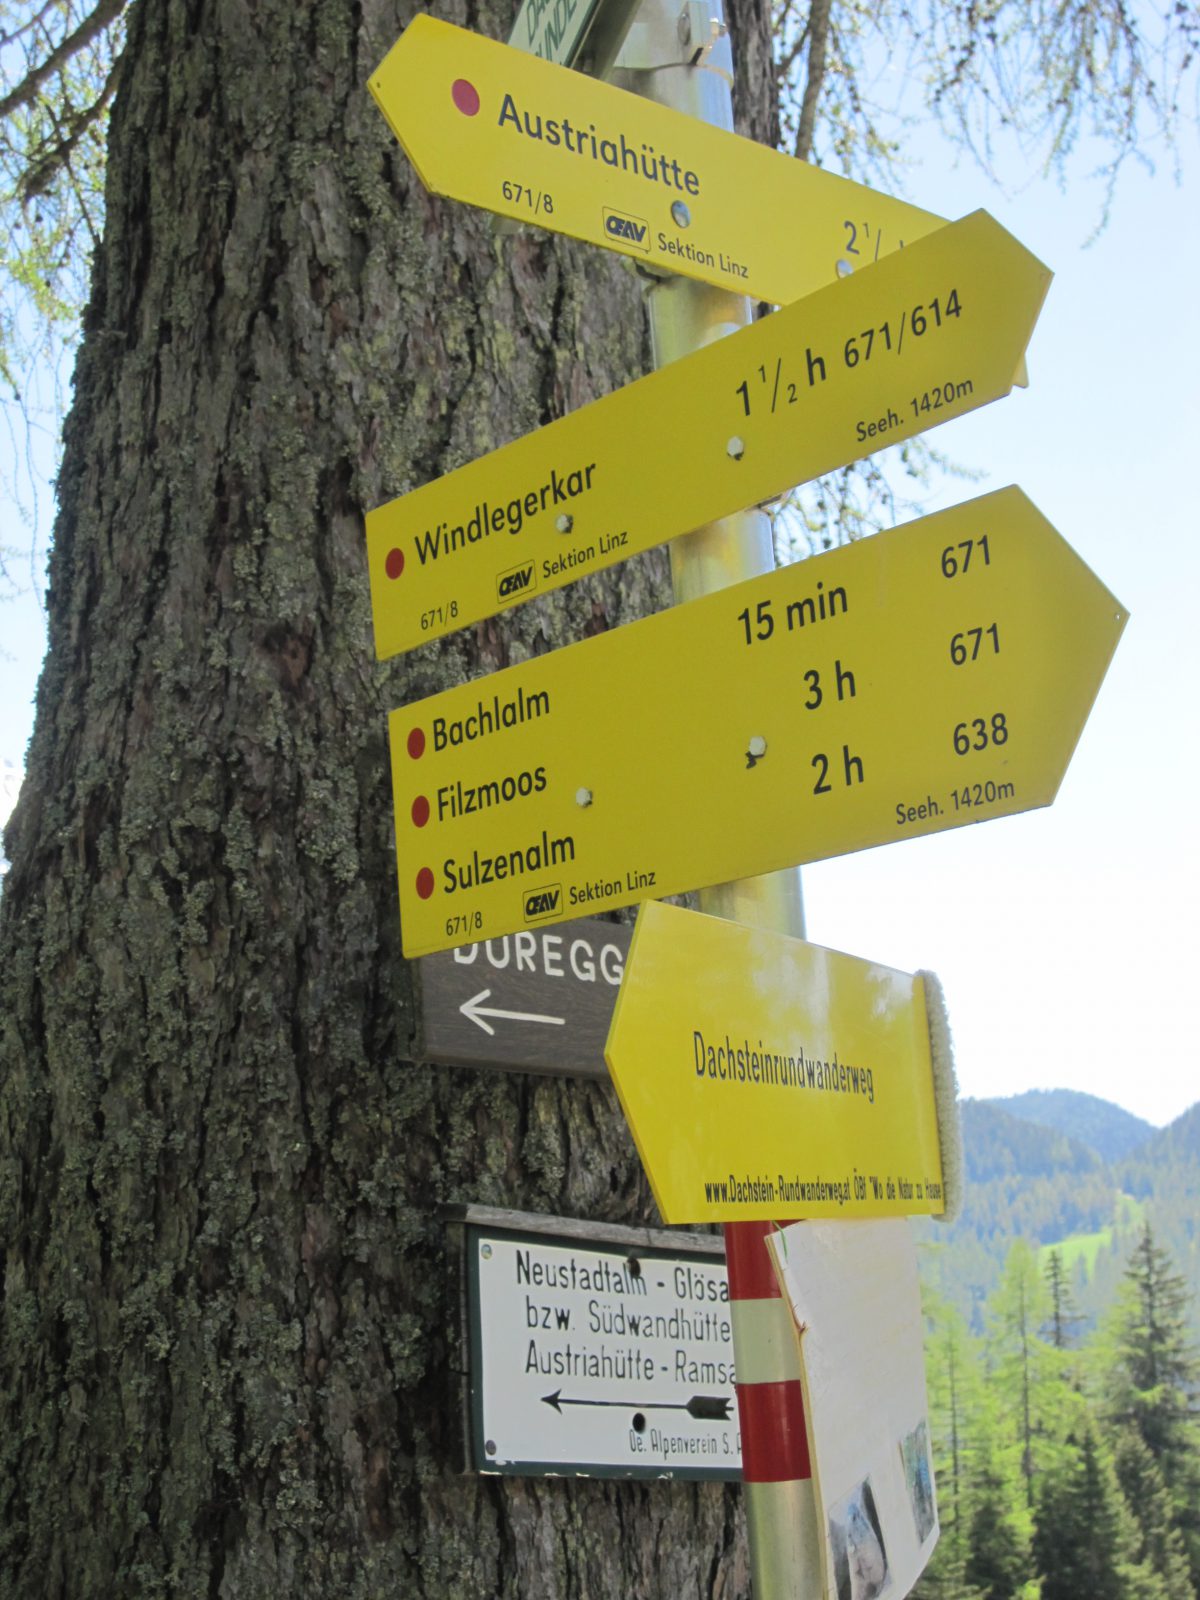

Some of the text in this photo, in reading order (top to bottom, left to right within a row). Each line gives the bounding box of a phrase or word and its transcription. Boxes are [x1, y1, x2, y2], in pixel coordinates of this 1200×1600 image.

[498, 94, 700, 196] Austriahütte
[502, 180, 554, 215] 671/8
[657, 232, 715, 267] Sektion
[720, 252, 749, 279] Linz
[414, 463, 597, 566] Windlegerkar
[805, 348, 827, 386] h
[844, 288, 963, 368] 671/614
[856, 379, 974, 442] Seeh. 1420m
[542, 545, 595, 579] Sektion
[599, 531, 629, 554] Linz
[420, 600, 459, 631] 671/8
[433, 534, 990, 752] Bachlalm 15 min 671
[437, 622, 1000, 822] Filzmoos 3 h 671
[443, 712, 1009, 894] Sulzenalm 2 h 638
[895, 780, 1015, 825] Seeh. 1420m
[569, 880, 622, 906] Sektion
[626, 870, 656, 891] Linz
[446, 911, 482, 937] 671/8
[693, 1031, 874, 1103] Dachsteinrundwanderweg
[516, 1250, 647, 1296] Neustadtalm
[674, 1267, 728, 1302] Glösa
[526, 1295, 731, 1343] bzw. Südwandhütte
[525, 1339, 654, 1381] Austriahütte
[650, 1428, 717, 1461] Alpenverein
